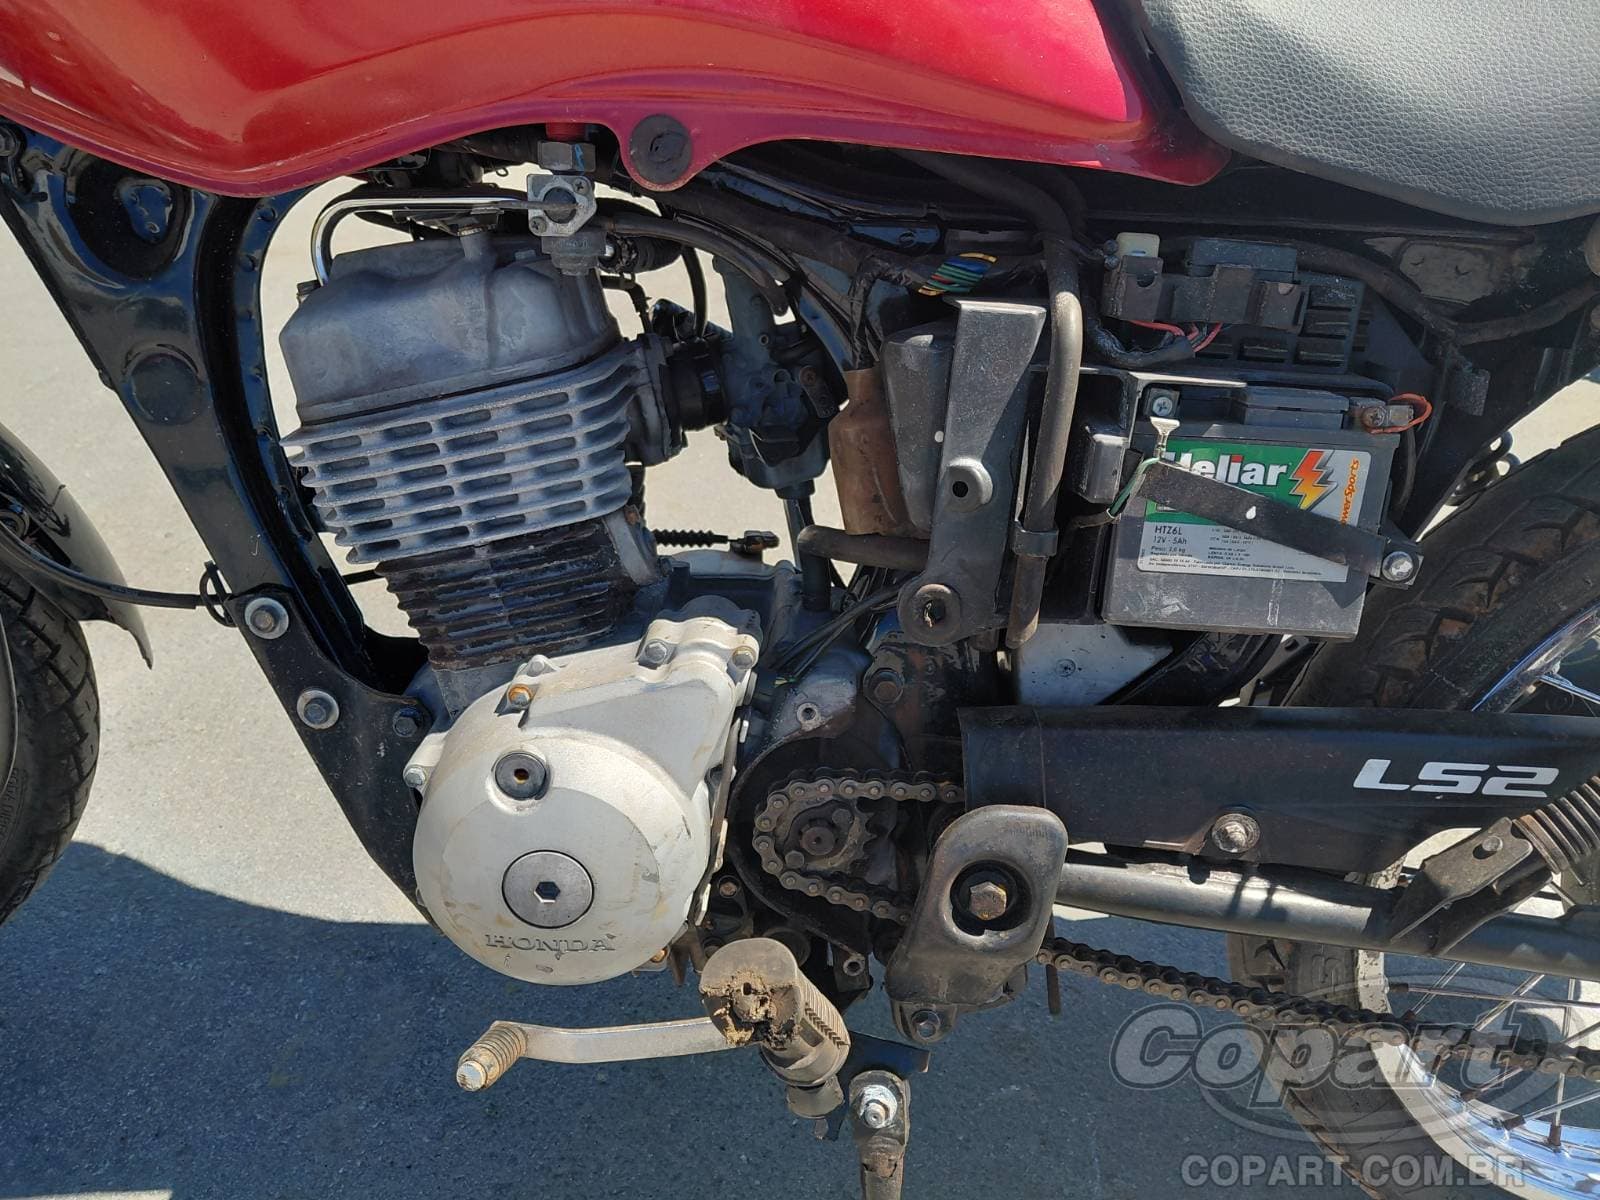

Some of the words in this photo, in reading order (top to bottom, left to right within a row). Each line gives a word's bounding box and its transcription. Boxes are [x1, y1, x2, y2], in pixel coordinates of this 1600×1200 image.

[1341, 459, 1359, 526] owerSports
[1154, 525, 1183, 535] HTZ6L
[1153, 535, 1167, 544] 12V
[1353, 759, 1559, 798] LS2
[485, 934, 616, 951] HONDA
